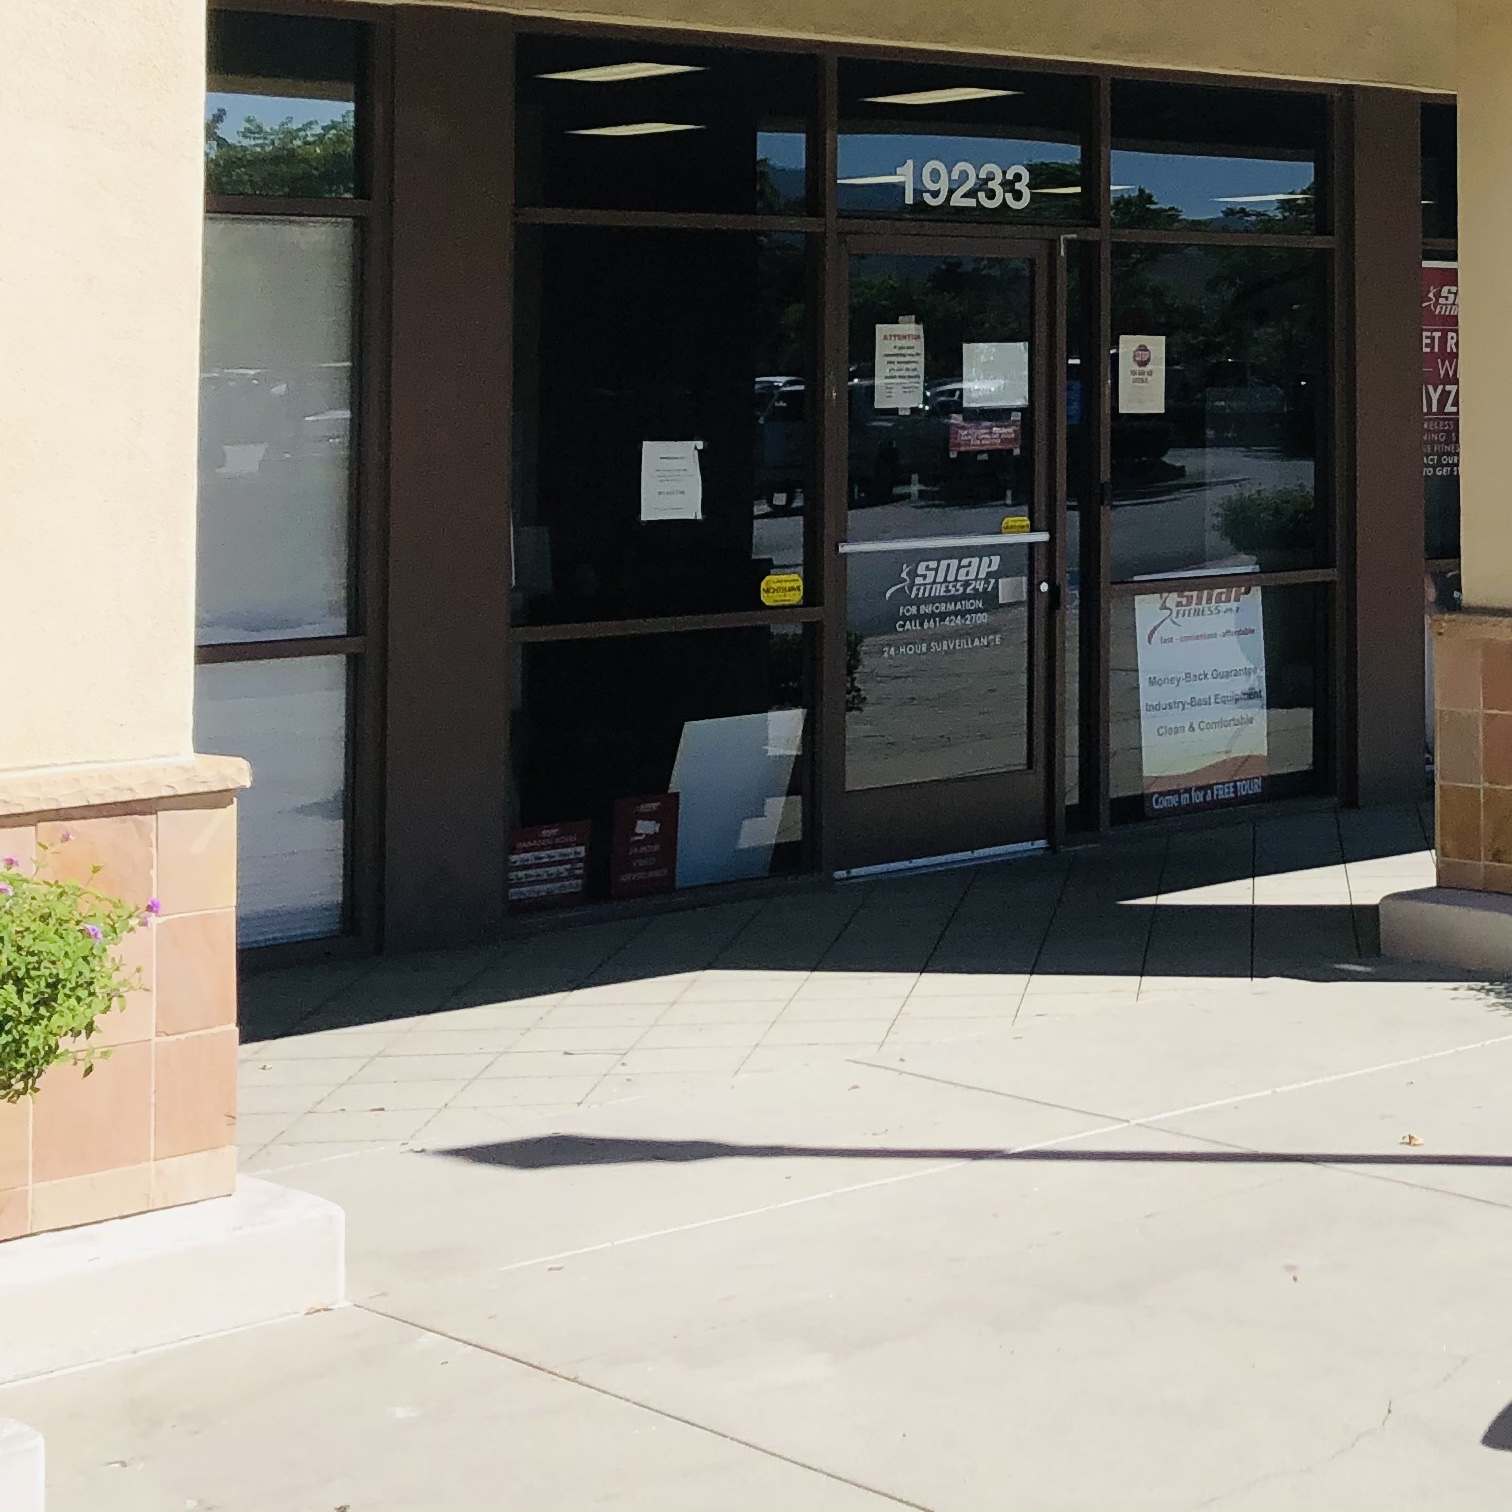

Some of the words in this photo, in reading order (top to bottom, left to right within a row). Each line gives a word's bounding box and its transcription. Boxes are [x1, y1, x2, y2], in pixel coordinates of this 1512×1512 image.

[896, 159, 1031, 210] 19233
[1438, 285, 1458, 305] S
[1435, 466, 1451, 475] GET
[911, 581, 964, 599] FITNESS
[966, 578, 996, 594] 24-7
[899, 605, 917, 616] FOR
[919, 599, 984, 615] INFORMATION
[1175, 605, 1221, 618] FITNESS
[895, 619, 921, 632] CALL
[882, 642, 927, 658] 24-HOUR
[930, 634, 1002, 652] SURVEILLANCE
[1148, 670, 1209, 688] Money-Back
[1145, 694, 1212, 713] Industry-Best
[1214, 688, 1263, 706] Equipment
[1156, 724, 1185, 737] Clean
[1188, 721, 1196, 733] &
[1198, 714, 1254, 732] Comfortable
[1152, 793, 1179, 809] Come
[1180, 790, 1190, 805] in
[1191, 787, 1205, 804] for
[1206, 791, 1212, 802] a
[1213, 784, 1235, 800] FREE
[1236, 778, 1262, 796] TOUR!
